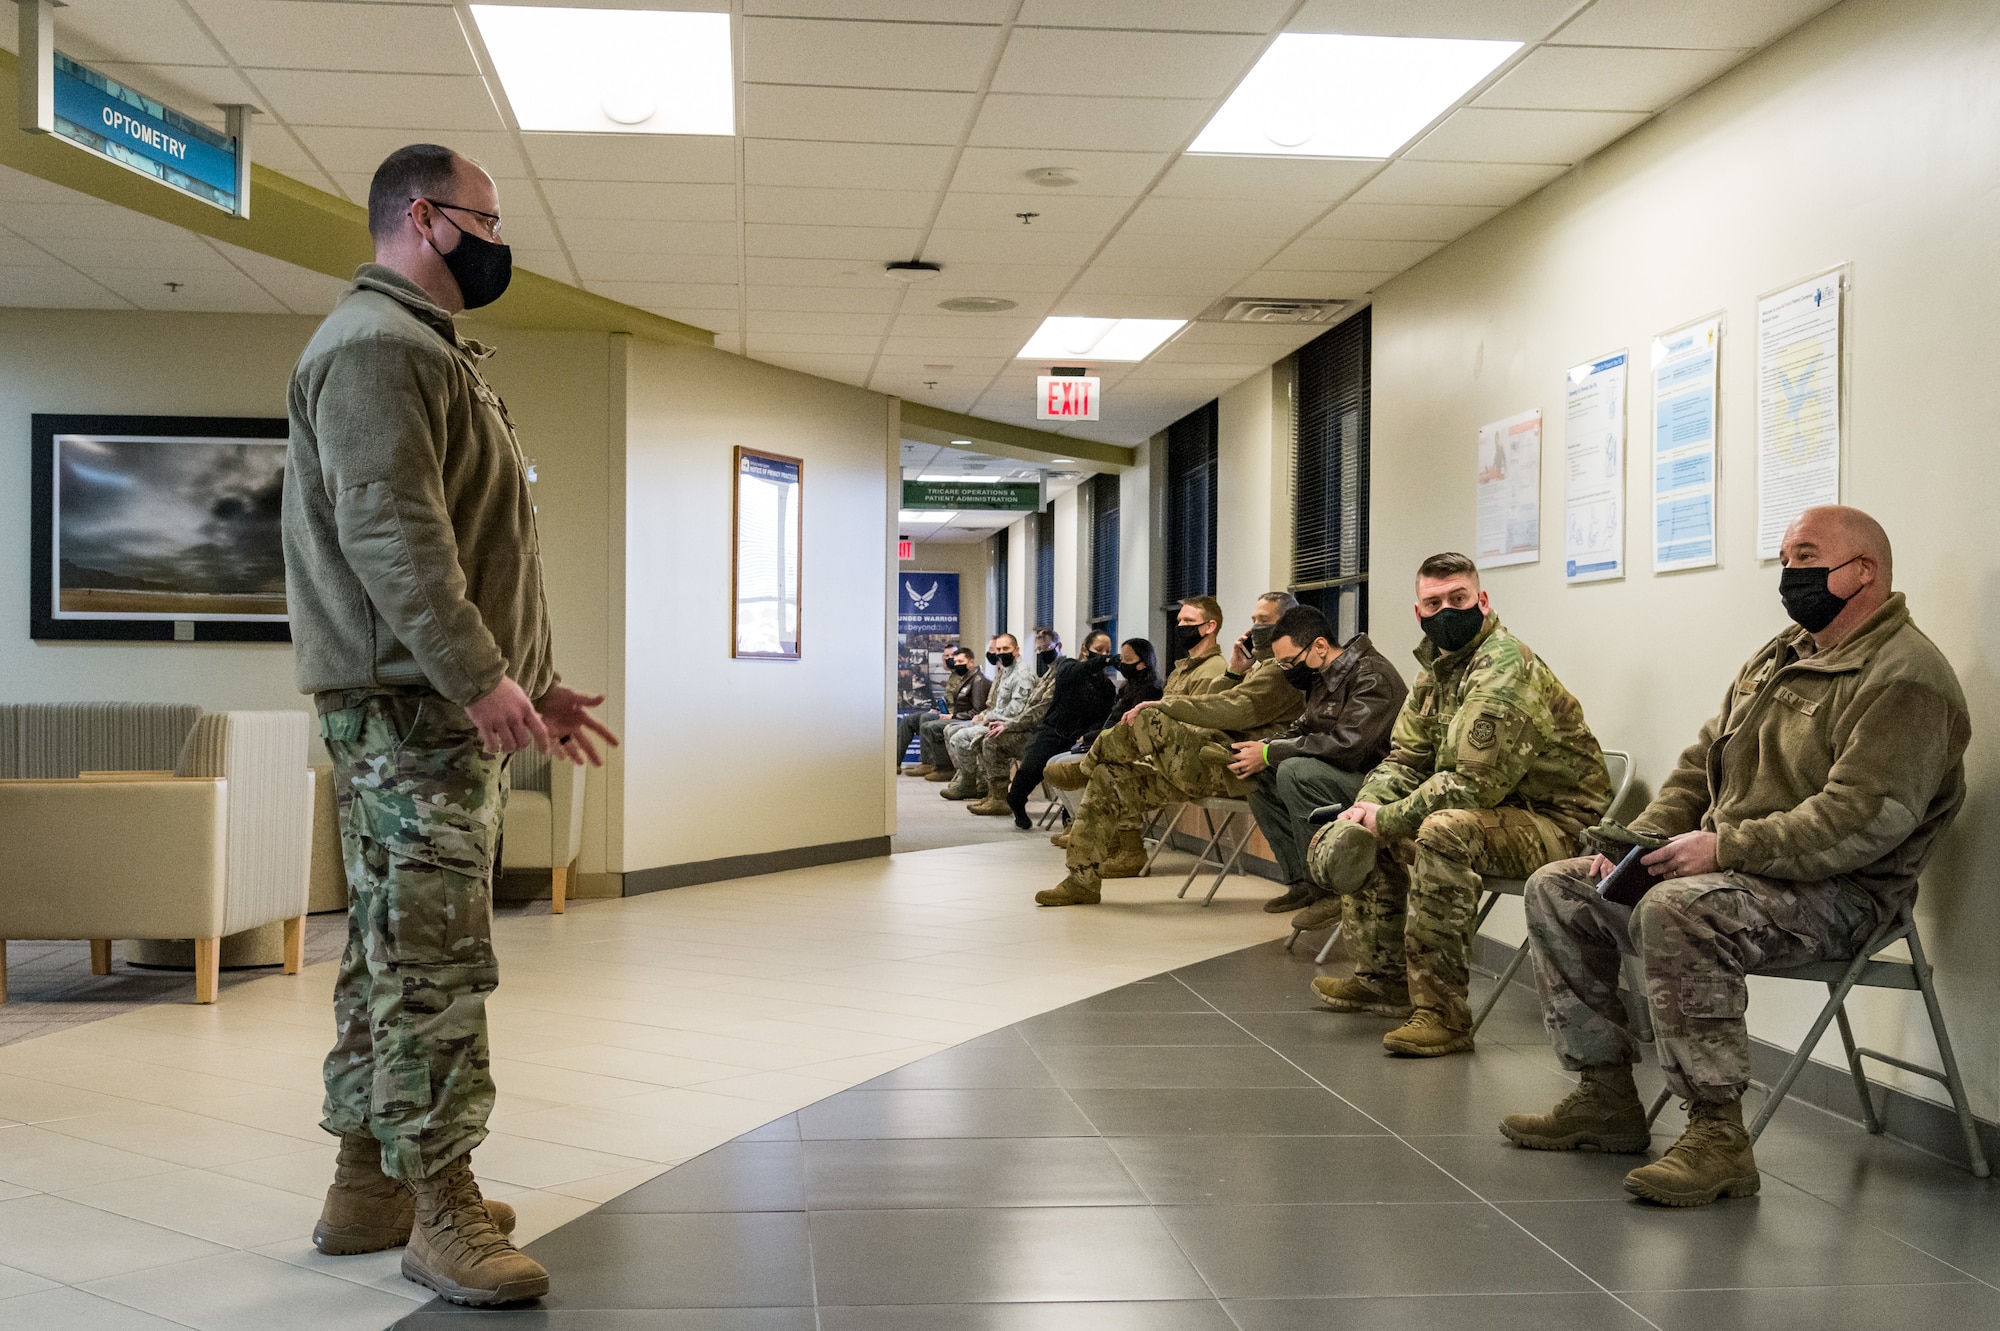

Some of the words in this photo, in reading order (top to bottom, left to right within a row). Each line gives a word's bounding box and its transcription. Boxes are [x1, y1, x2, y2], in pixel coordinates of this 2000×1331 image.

[102, 106, 186, 160] OPTOMETRY
[1048, 381, 1092, 416] EXIT
[956, 495, 1018, 503] ADMINISTRATION
